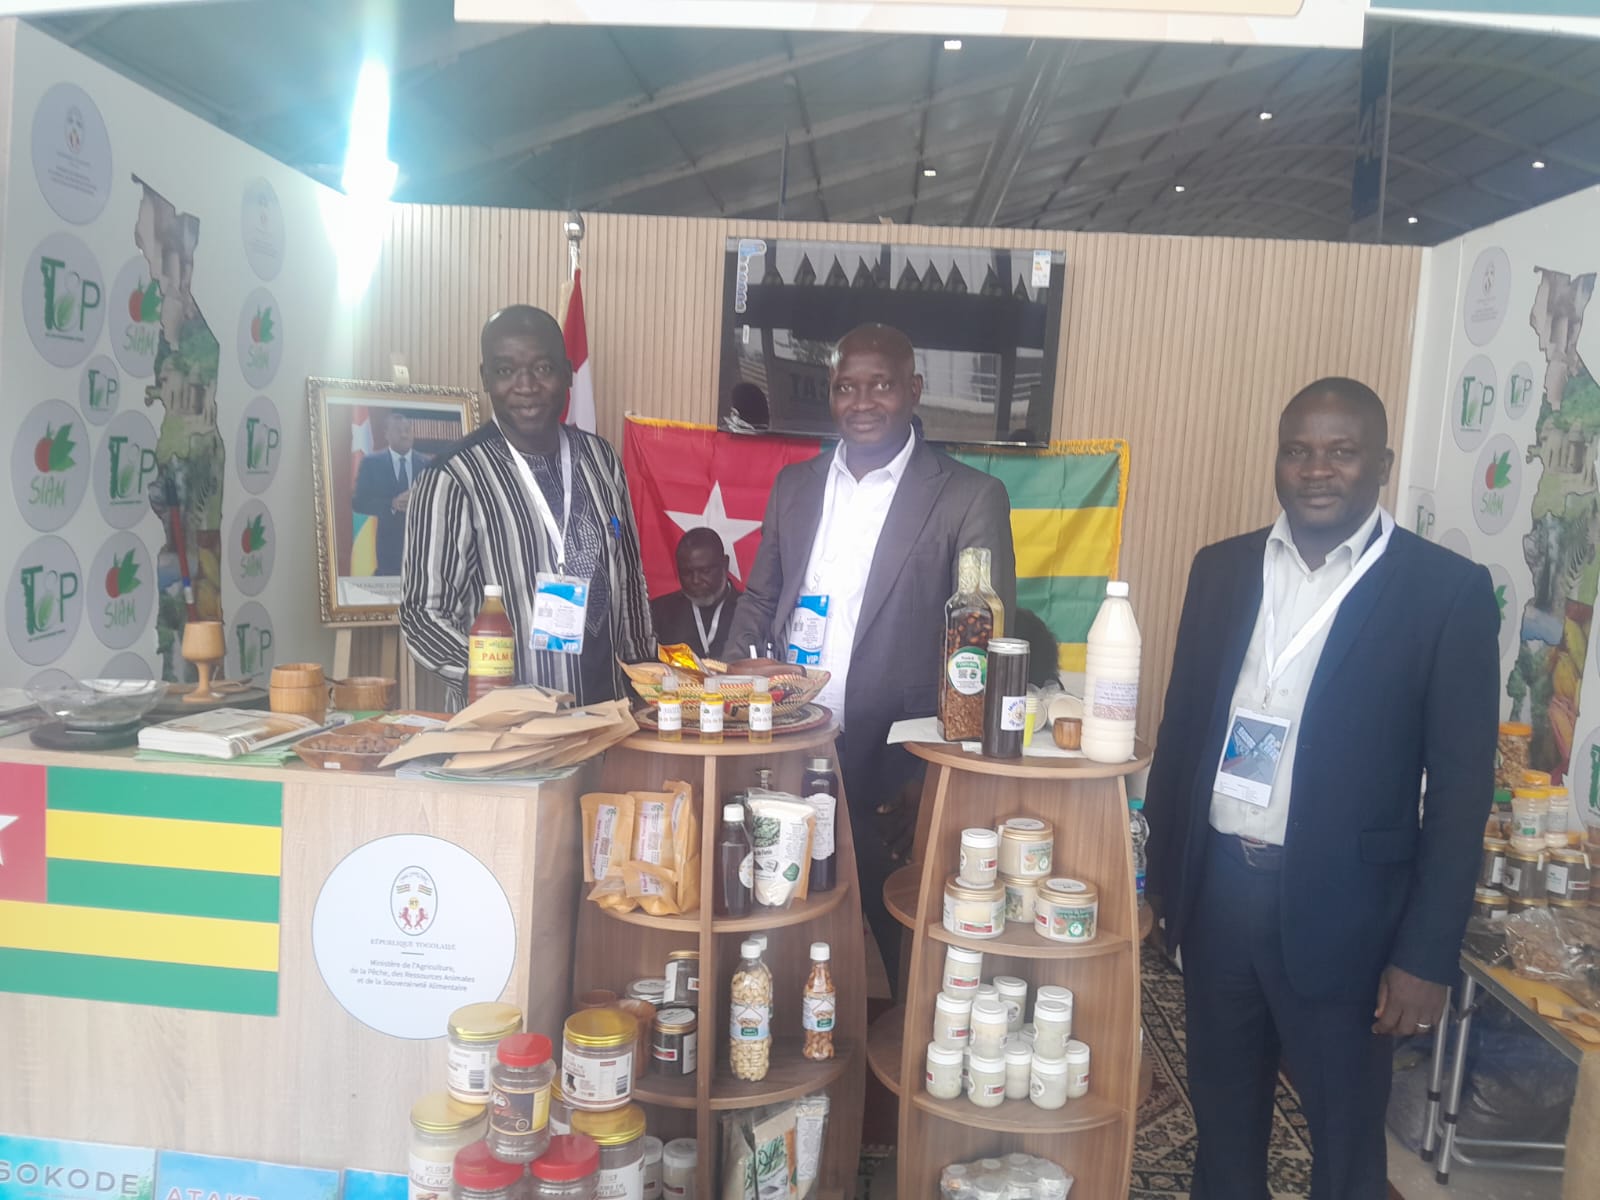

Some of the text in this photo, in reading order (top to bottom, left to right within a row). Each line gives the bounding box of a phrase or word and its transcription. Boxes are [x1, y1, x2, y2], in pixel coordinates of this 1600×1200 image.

[28, 475, 67, 508] SIAM
[104, 599, 137, 629] SIAM
[562, 641, 578, 652] VIP
[481, 652, 509, 662] PALM
[806, 655, 819, 665] VIP
[370, 959, 401, 969] Ministère
[402, 961, 411, 969] de
[350, 967, 475, 984] de la Pêche, des Ressources Animales
[365, 977, 374, 985] de
[375, 977, 382, 986] la
[383, 978, 427, 989] Souveraineté
[428, 981, 468, 992] Alimentaire
[0, 1160, 139, 1196] SOKODE
